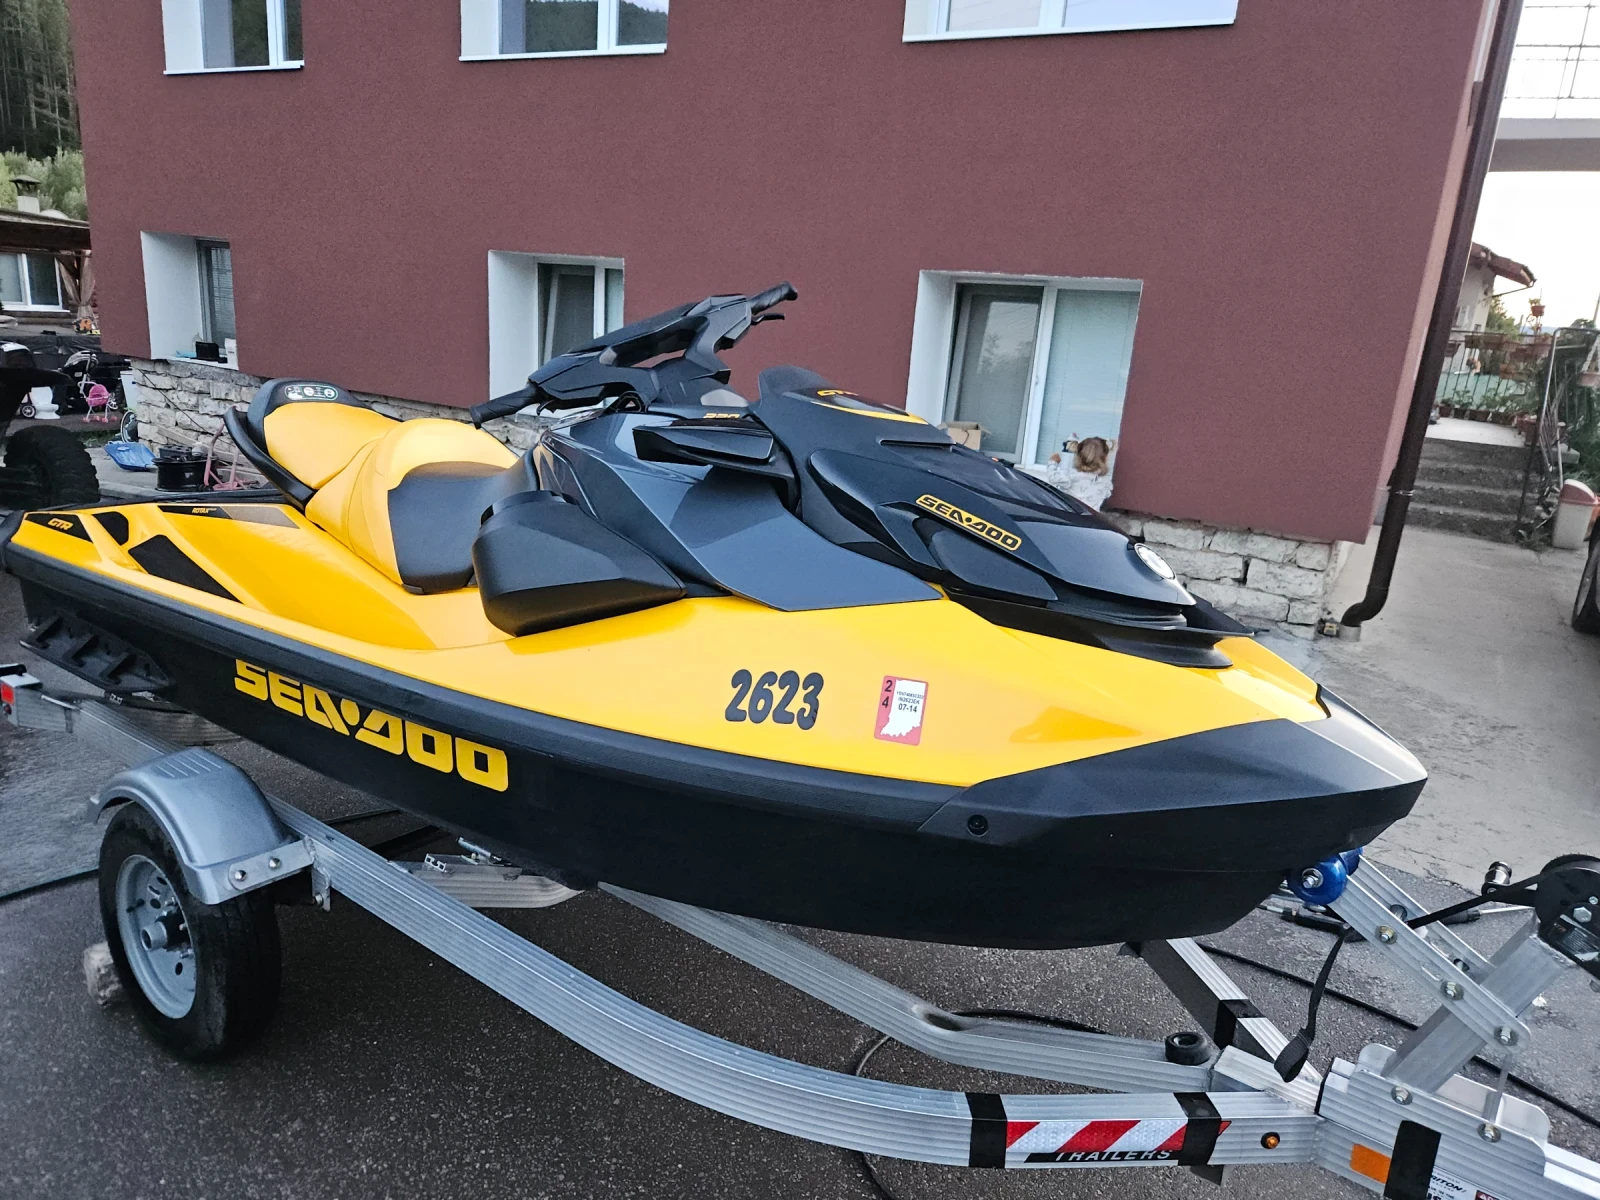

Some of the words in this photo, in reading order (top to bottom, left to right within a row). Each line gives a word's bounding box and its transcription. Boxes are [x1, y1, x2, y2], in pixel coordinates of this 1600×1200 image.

[47, 518, 74, 530] GTR
[725, 669, 824, 730] 2623
[898, 703, 918, 713] 07-14
[1055, 1150, 1173, 1162] TRAILERS
[1431, 1175, 1463, 1191] RITON
